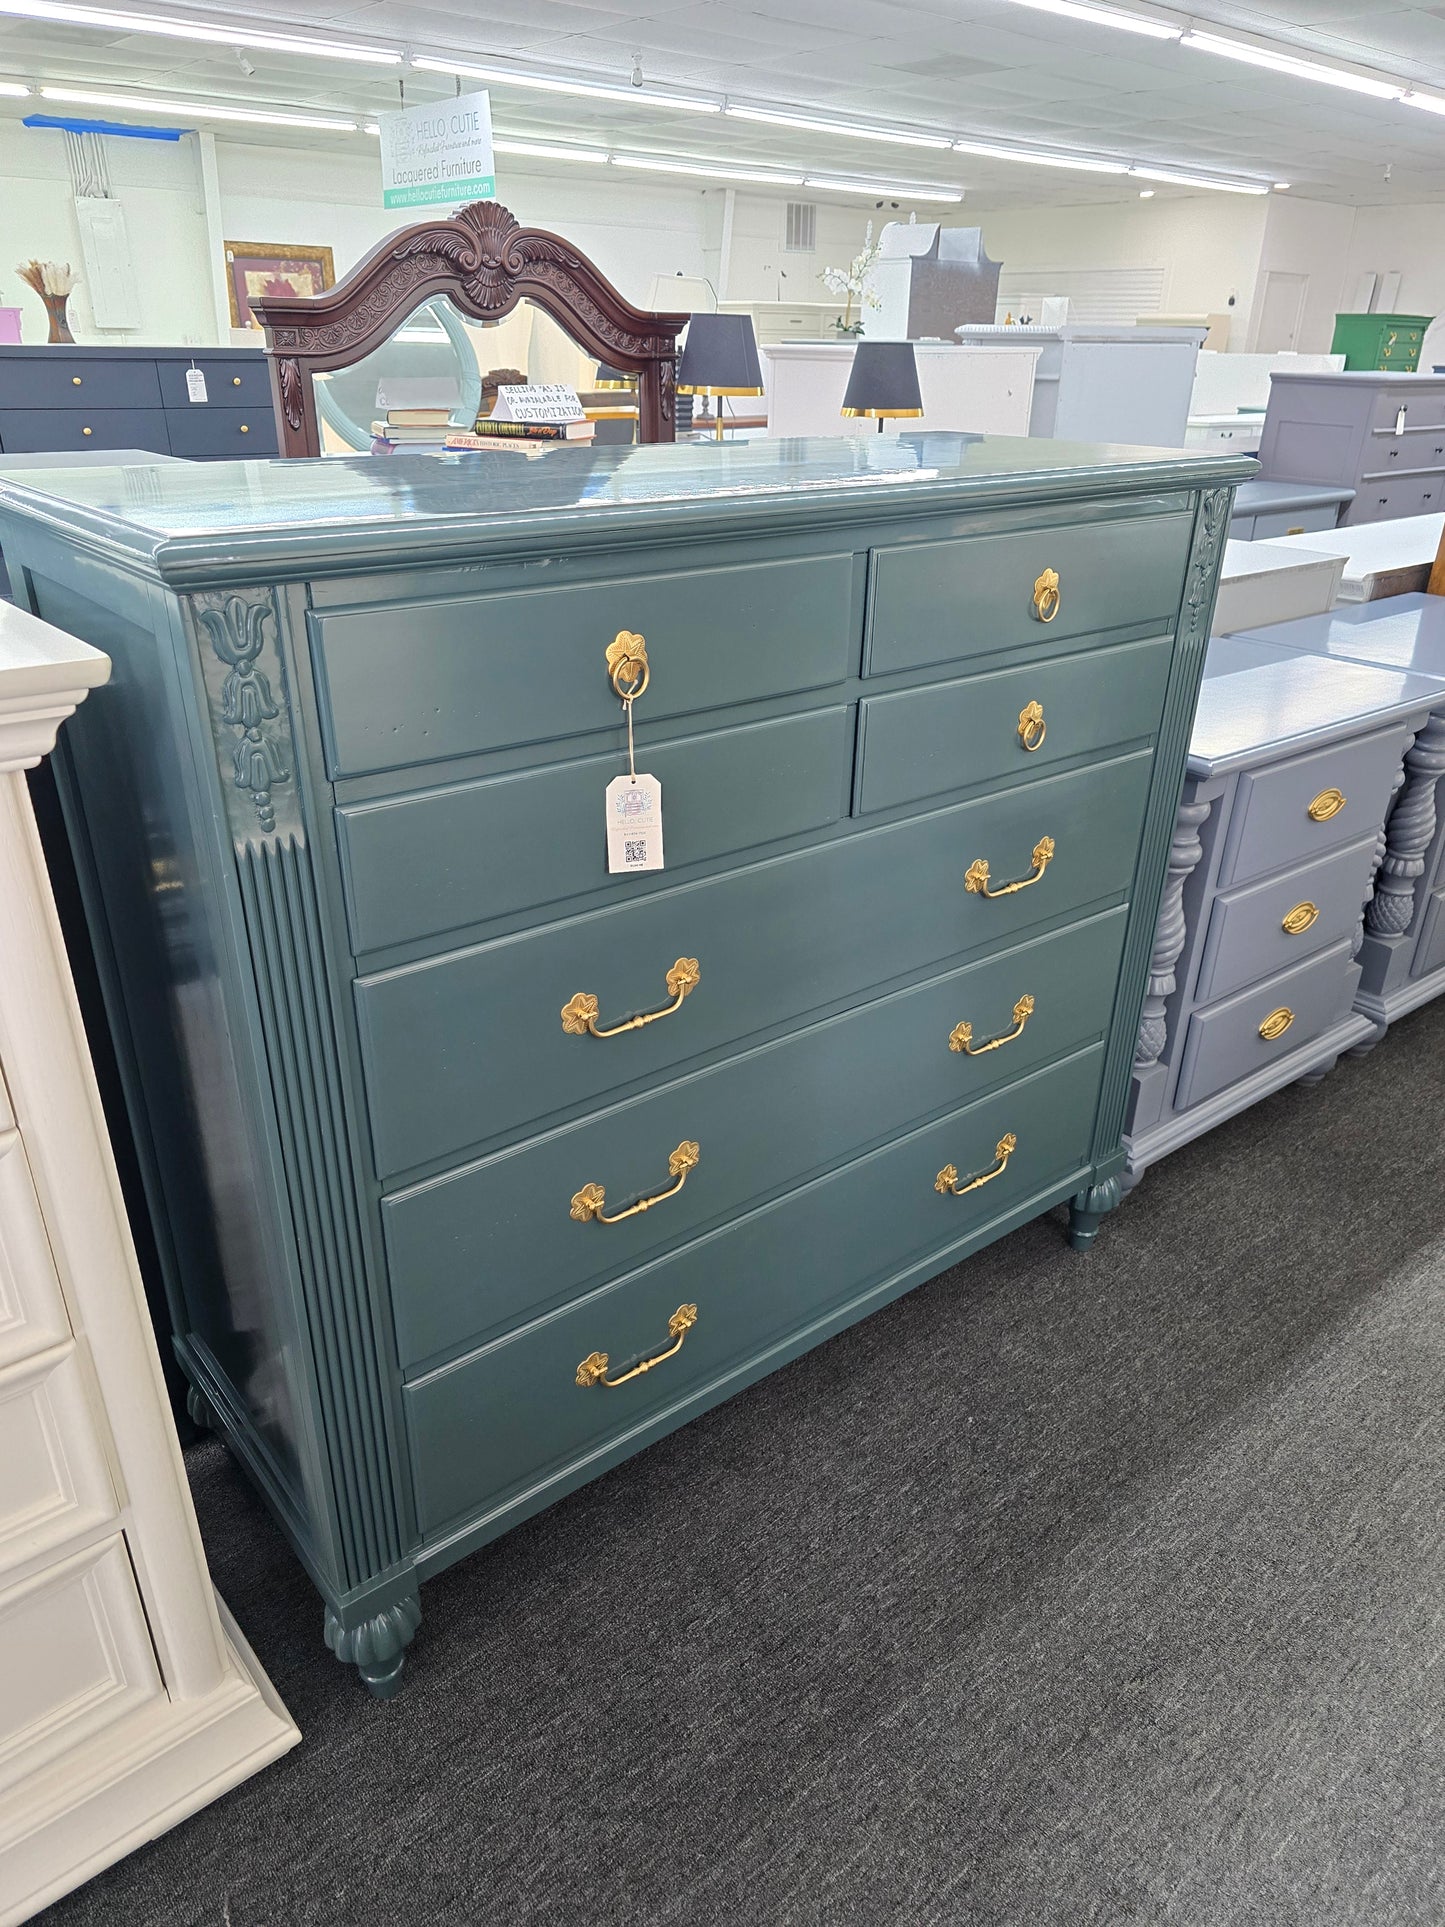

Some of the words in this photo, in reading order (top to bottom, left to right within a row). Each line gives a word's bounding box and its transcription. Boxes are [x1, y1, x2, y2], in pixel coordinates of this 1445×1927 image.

[416, 119, 448, 140] HELLO,
[451, 111, 480, 135] CUTIE
[393, 162, 439, 187] Lacquered
[441, 157, 482, 177] Furniture
[390, 182, 490, 204] www.hellocutiefurniture.com
[514, 406, 584, 419] CUSTOMIZATION
